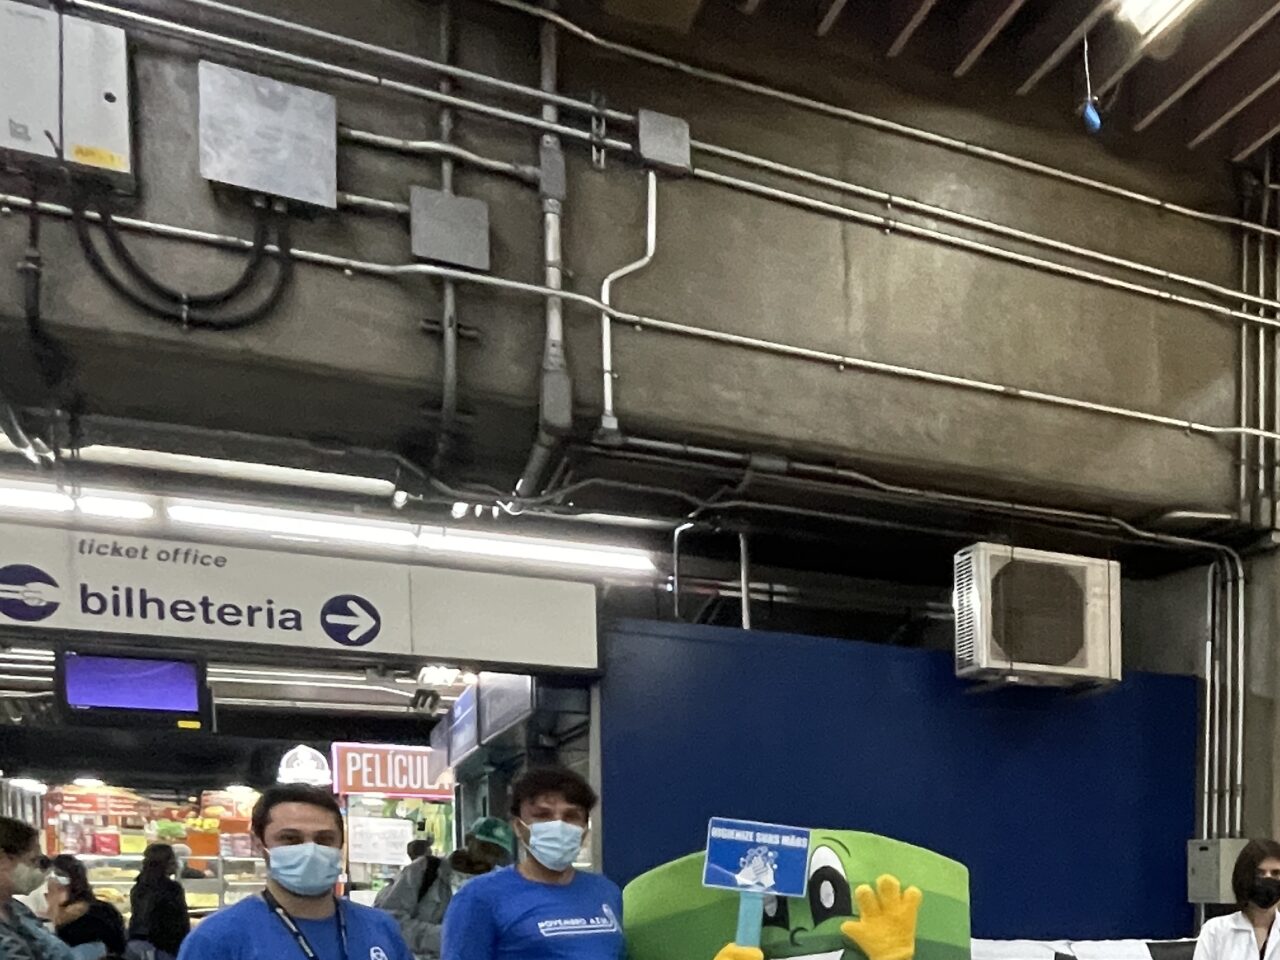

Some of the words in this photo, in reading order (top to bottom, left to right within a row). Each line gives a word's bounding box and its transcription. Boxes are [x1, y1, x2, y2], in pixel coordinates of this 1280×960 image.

[78, 538, 149, 561] ticket
[156, 547, 228, 569] office
[80, 582, 303, 632] bilheteria
